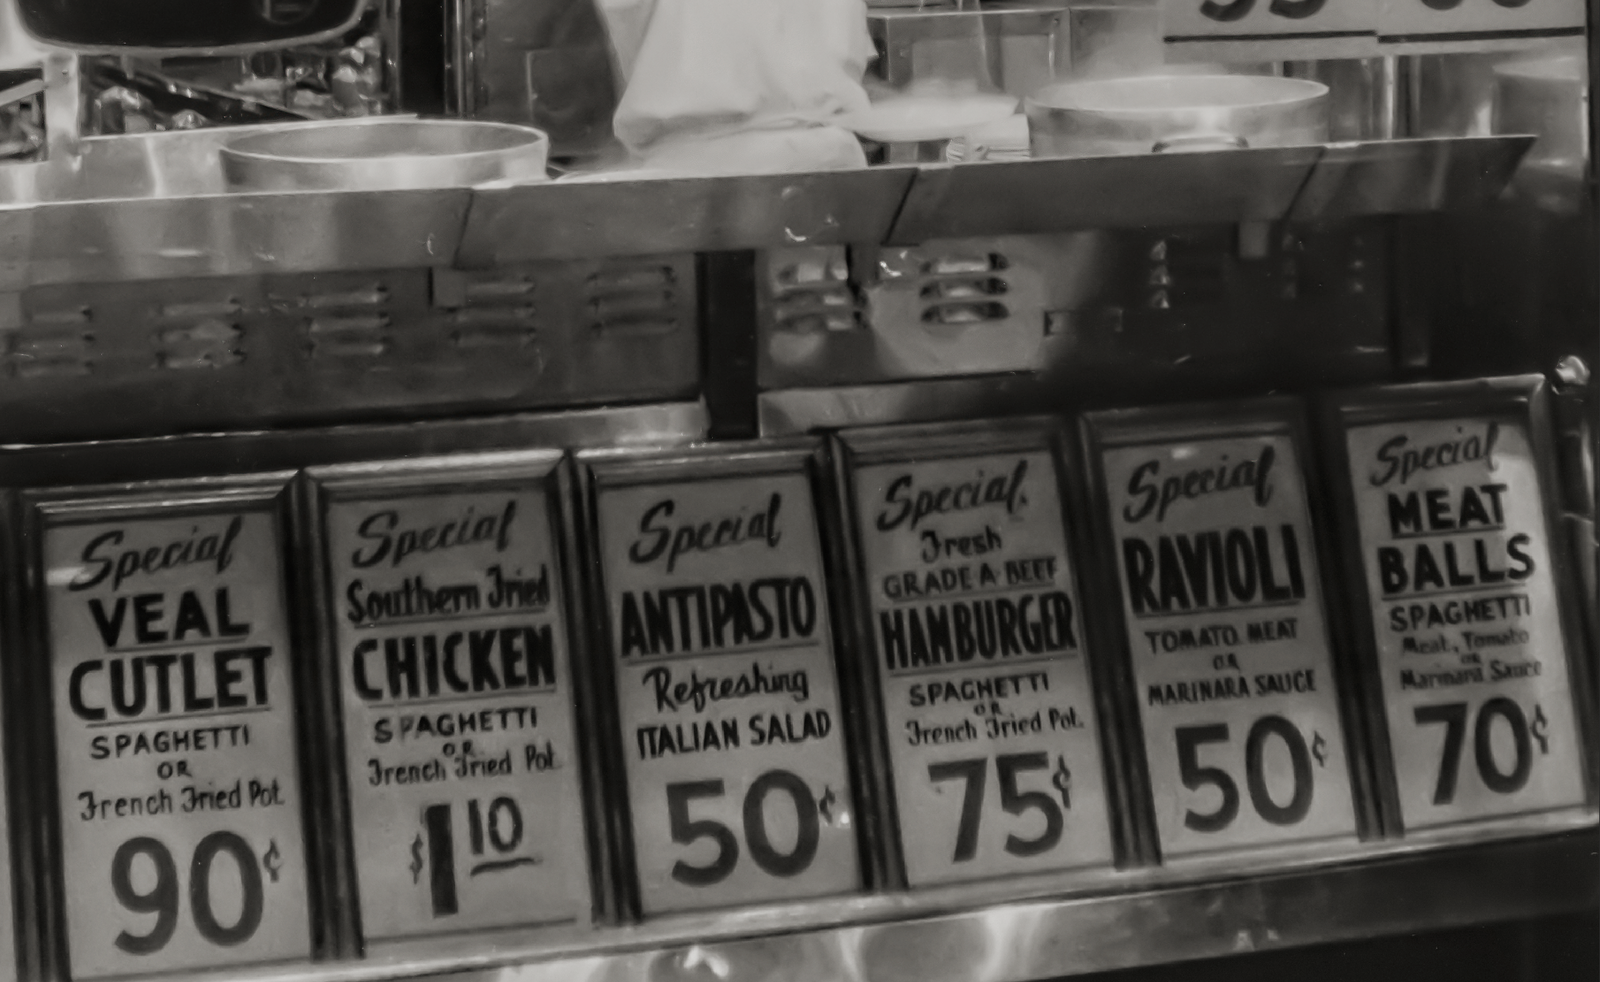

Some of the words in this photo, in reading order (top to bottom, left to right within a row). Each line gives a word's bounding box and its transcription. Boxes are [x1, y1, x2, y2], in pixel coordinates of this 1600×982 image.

[1370, 421, 1499, 487] Special
[1123, 446, 1275, 523] Special
[1387, 484, 1507, 534] MEAT
[68, 515, 242, 592] Special
[352, 501, 516, 568] Special
[629, 492, 781, 574] Special
[922, 526, 1002, 564] Fresh
[884, 567, 972, 599] GRADE
[980, 562, 997, 588] A
[1005, 556, 1056, 586] BEEF
[1123, 524, 1305, 614] RAVIOLI
[1377, 533, 1535, 595] BALLS
[88, 586, 250, 647] VEAL
[347, 574, 481, 624] Southern
[486, 563, 548, 609] Fried
[621, 576, 817, 659] ANTIPASTO
[1390, 594, 1530, 632] SPAGHETTI
[879, 592, 1076, 670] HAMBURGER
[1145, 625, 1238, 654] TOMATO
[1247, 618, 1297, 642] MEAT
[1461, 628, 1530, 650] Tomato
[69, 646, 272, 721] CUTLET
[352, 624, 555, 700] CHICKEN
[1148, 677, 1249, 705] MARINARA
[1255, 670, 1316, 695] SAUCE
[1401, 667, 1484, 690] Marinara
[1489, 660, 1542, 681] Sauce
[643, 662, 809, 714] Refreshing
[909, 672, 1049, 707] SPAGHETTI
[91, 725, 249, 759] SPAGHETTI
[374, 706, 538, 743] SPAGHETTI
[637, 717, 740, 761] ITALIAN
[748, 708, 831, 745] SALAD
[906, 719, 977, 746] French
[985, 711, 1041, 739] Fried
[157, 759, 192, 780] OR
[368, 759, 446, 786] French
[455, 750, 512, 778] Fried
[78, 790, 172, 821] French
[181, 779, 241, 812] Fried
